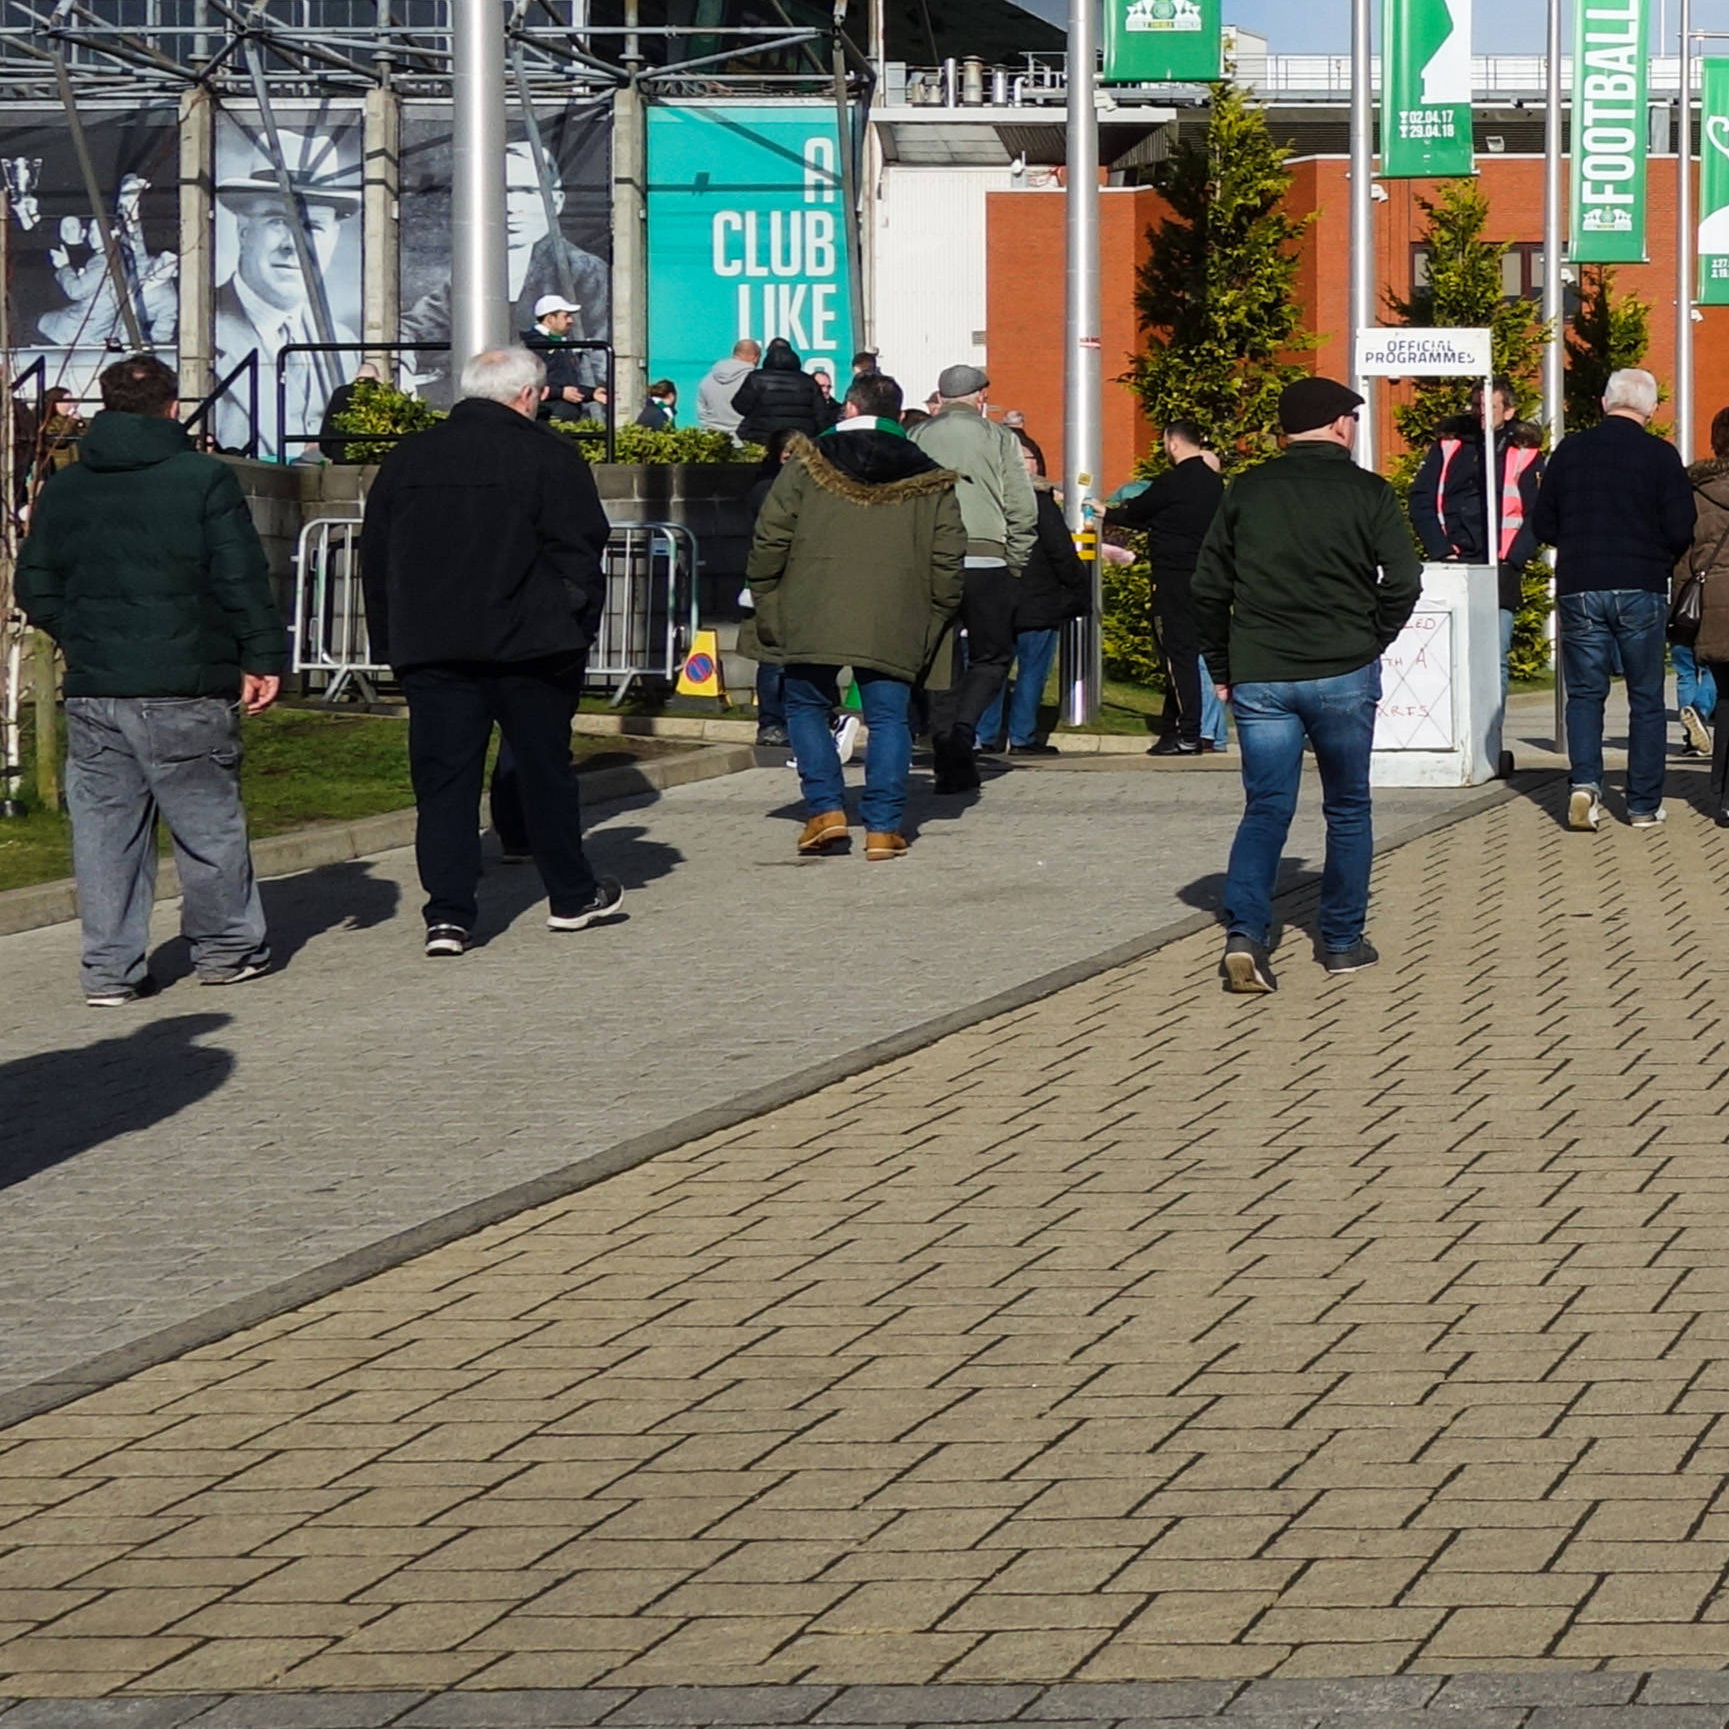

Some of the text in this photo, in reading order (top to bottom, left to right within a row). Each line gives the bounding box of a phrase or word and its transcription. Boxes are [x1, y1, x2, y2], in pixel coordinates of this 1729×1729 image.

[1409, 110, 1455, 124] 02.04.17
[804, 137, 835, 203] A
[712, 210, 836, 277] CLUB
[738, 284, 836, 350] LIKE
[1365, 352, 1476, 364] PROGRAMMES
[1386, 339, 1455, 352] OFFICIAL
